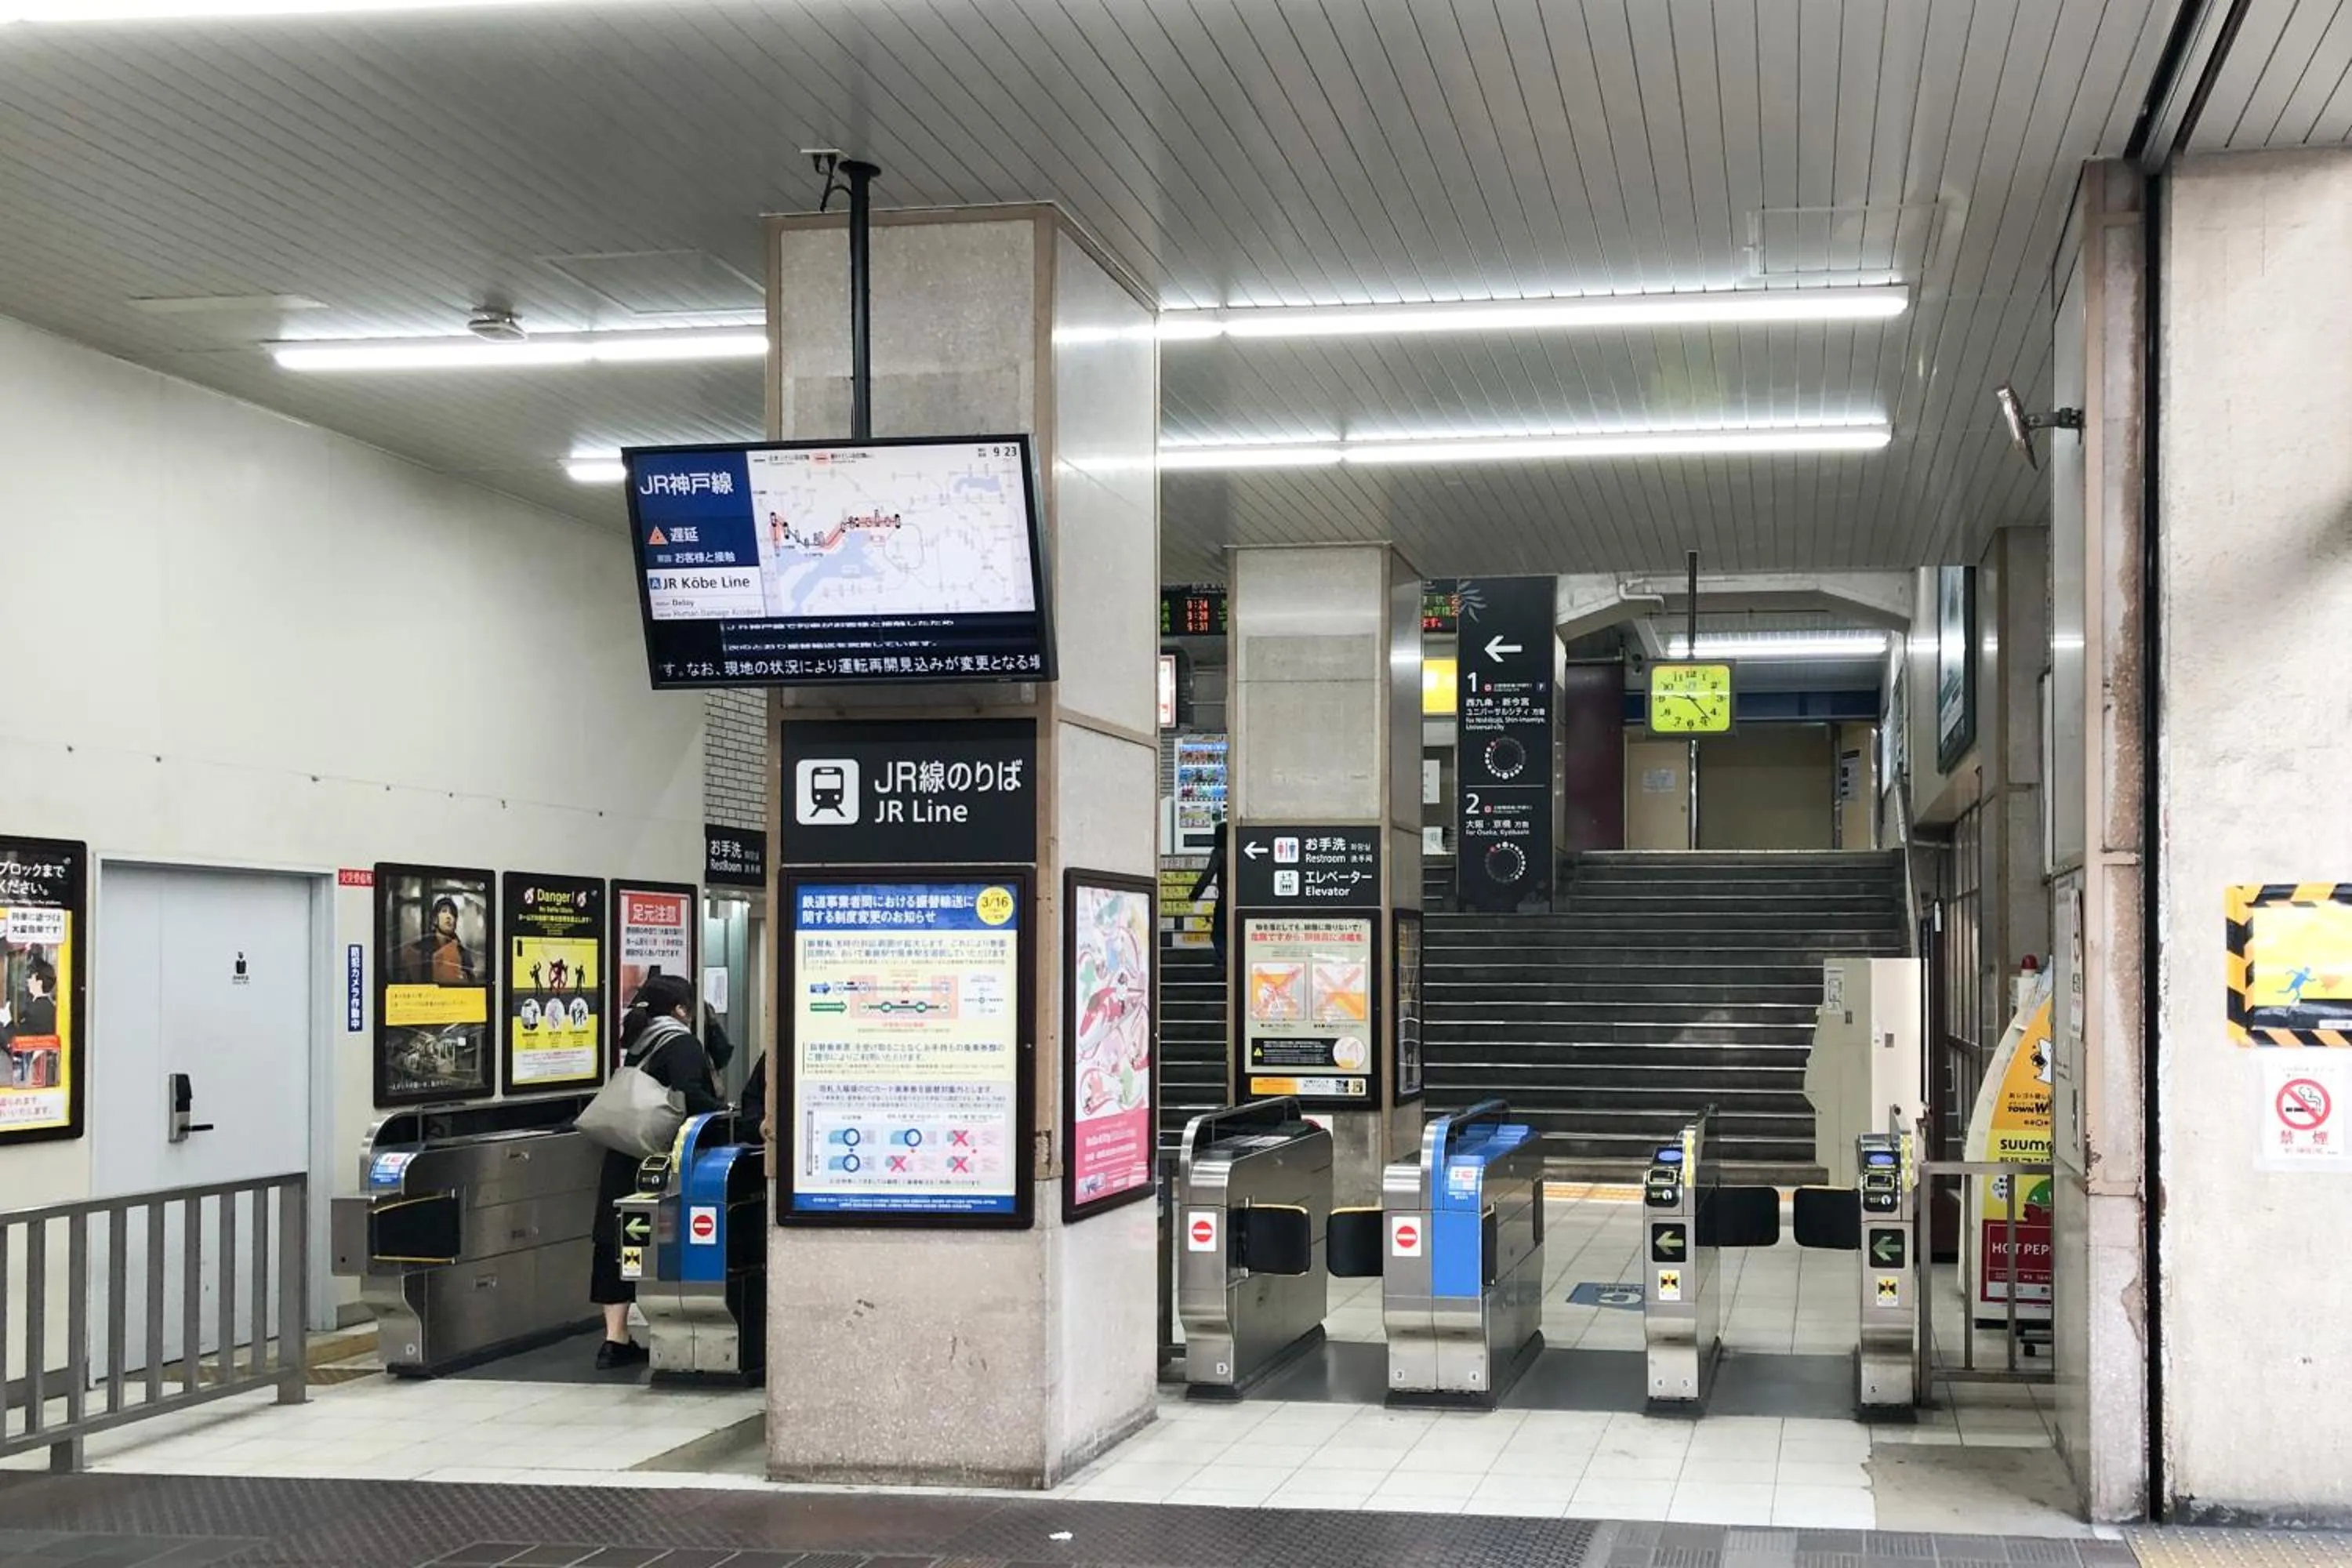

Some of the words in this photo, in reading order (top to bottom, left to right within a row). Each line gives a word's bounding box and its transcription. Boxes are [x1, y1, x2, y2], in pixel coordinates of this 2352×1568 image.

[993, 446, 1000, 456] 9
[1004, 446, 1017, 456] 23
[640, 472, 734, 495] JR神戸線
[670, 526, 699, 542] 遅延
[675, 552, 736, 563] お客様と接触
[663, 578, 677, 590] JR
[681, 577, 717, 590] Kōbe
[721, 574, 750, 589] Line
[1467, 671, 1477, 693] 1
[874, 759, 1023, 793] JR線のりば
[874, 800, 904, 822] JR
[913, 799, 968, 822] Line
[1465, 793, 1479, 814] 2
[710, 840, 742, 859] お手洗
[1305, 837, 1346, 852] お手洗
[1305, 852, 1346, 863] Restroom
[1305, 869, 1373, 884] エレベーター
[537, 887, 575, 906] Danger!
[1305, 884, 1351, 896] Elevator
[982, 895, 1009, 909] 3/16
[632, 902, 677, 923] 足元注意
[802, 909, 937, 924] 関する制度変更のお知らせ
[350, 946, 361, 1029] 防犯カメラ作動中
[2024, 1243, 2051, 1255] PEP
